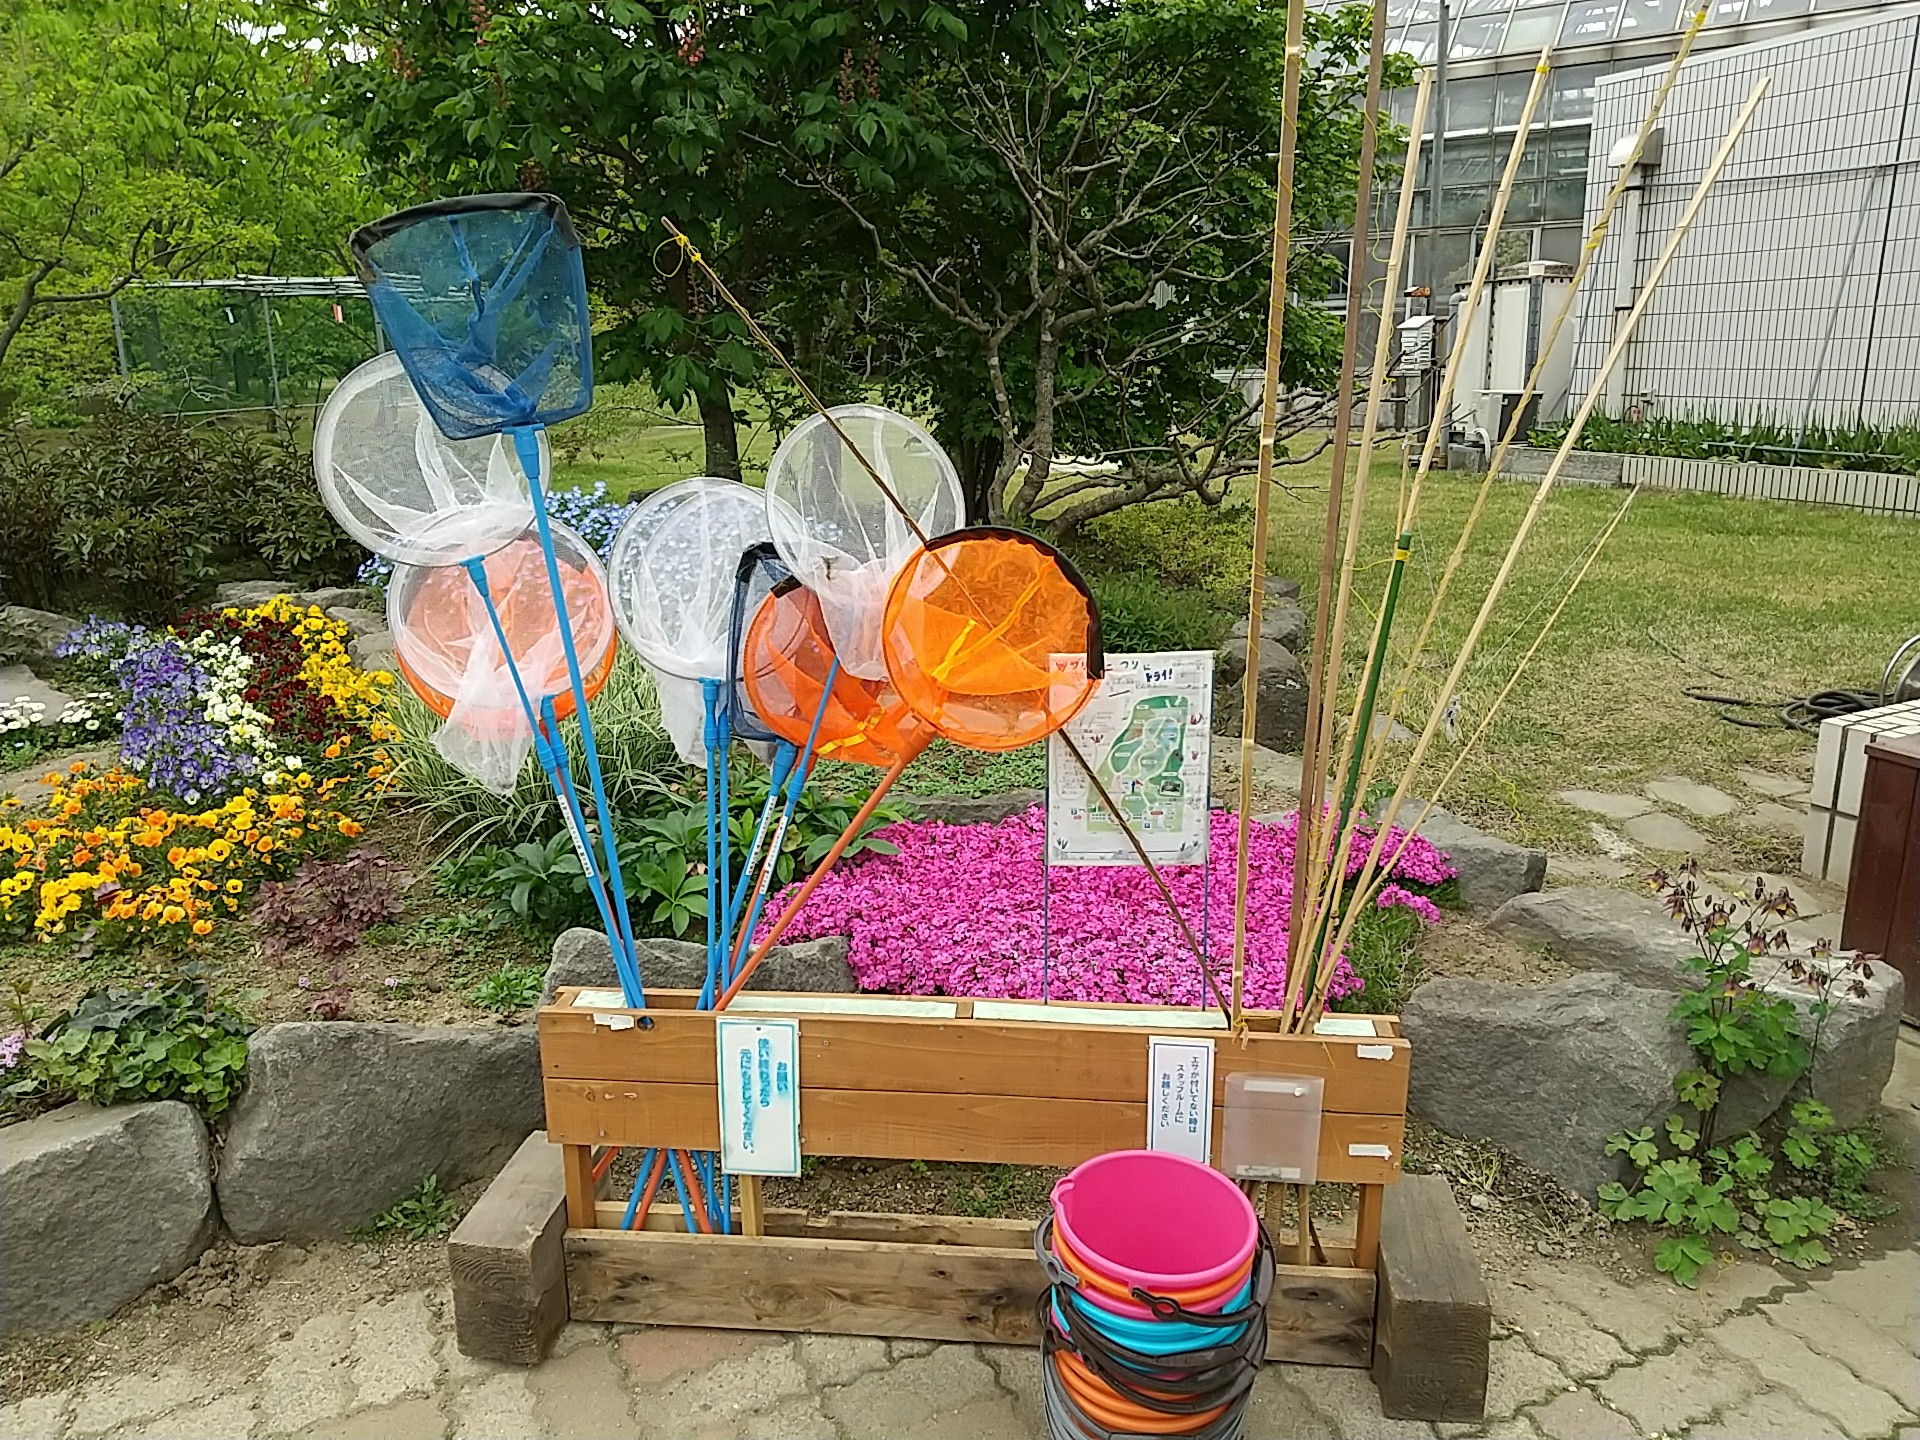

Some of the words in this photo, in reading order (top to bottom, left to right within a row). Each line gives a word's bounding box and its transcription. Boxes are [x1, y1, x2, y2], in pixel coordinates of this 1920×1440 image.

[1161, 1072, 1171, 1128] お越しください
[1174, 1064, 1186, 1124] スタッフルームに
[1188, 1056, 1200, 1133] エサが付いてない時は
